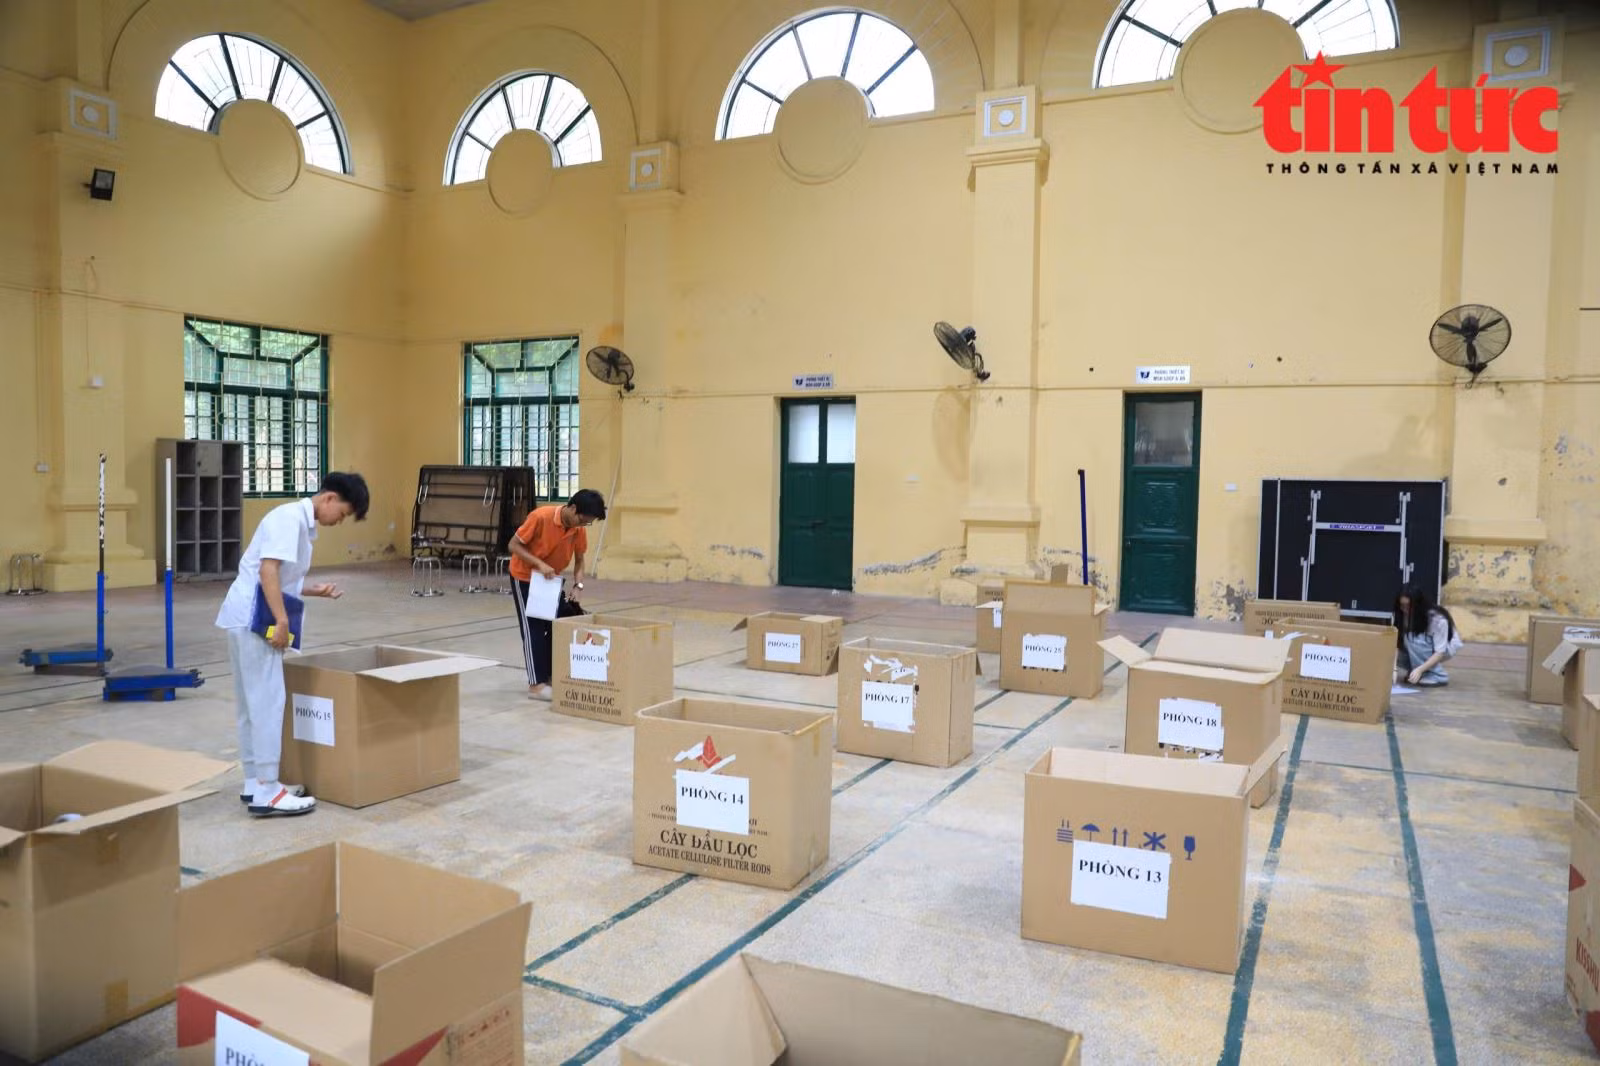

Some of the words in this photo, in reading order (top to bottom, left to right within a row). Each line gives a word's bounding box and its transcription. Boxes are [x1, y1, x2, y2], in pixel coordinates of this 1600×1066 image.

[900, 696, 910, 704] 17
[1163, 712, 1203, 726] PHÒNG
[1206, 718, 1217, 727] 18
[681, 786, 728, 803] PHÒNG
[731, 793, 744, 805] 14
[660, 827, 687, 846] CÂY
[728, 840, 758, 860] LỌC
[648, 844, 680, 860] ACETATE
[680, 851, 722, 867] CELLULOSE
[723, 857, 749, 872] FILTER
[750, 863, 771, 875] RODS
[1079, 860, 1140, 880] PHÒNG
[1146, 870, 1162, 883] 13
